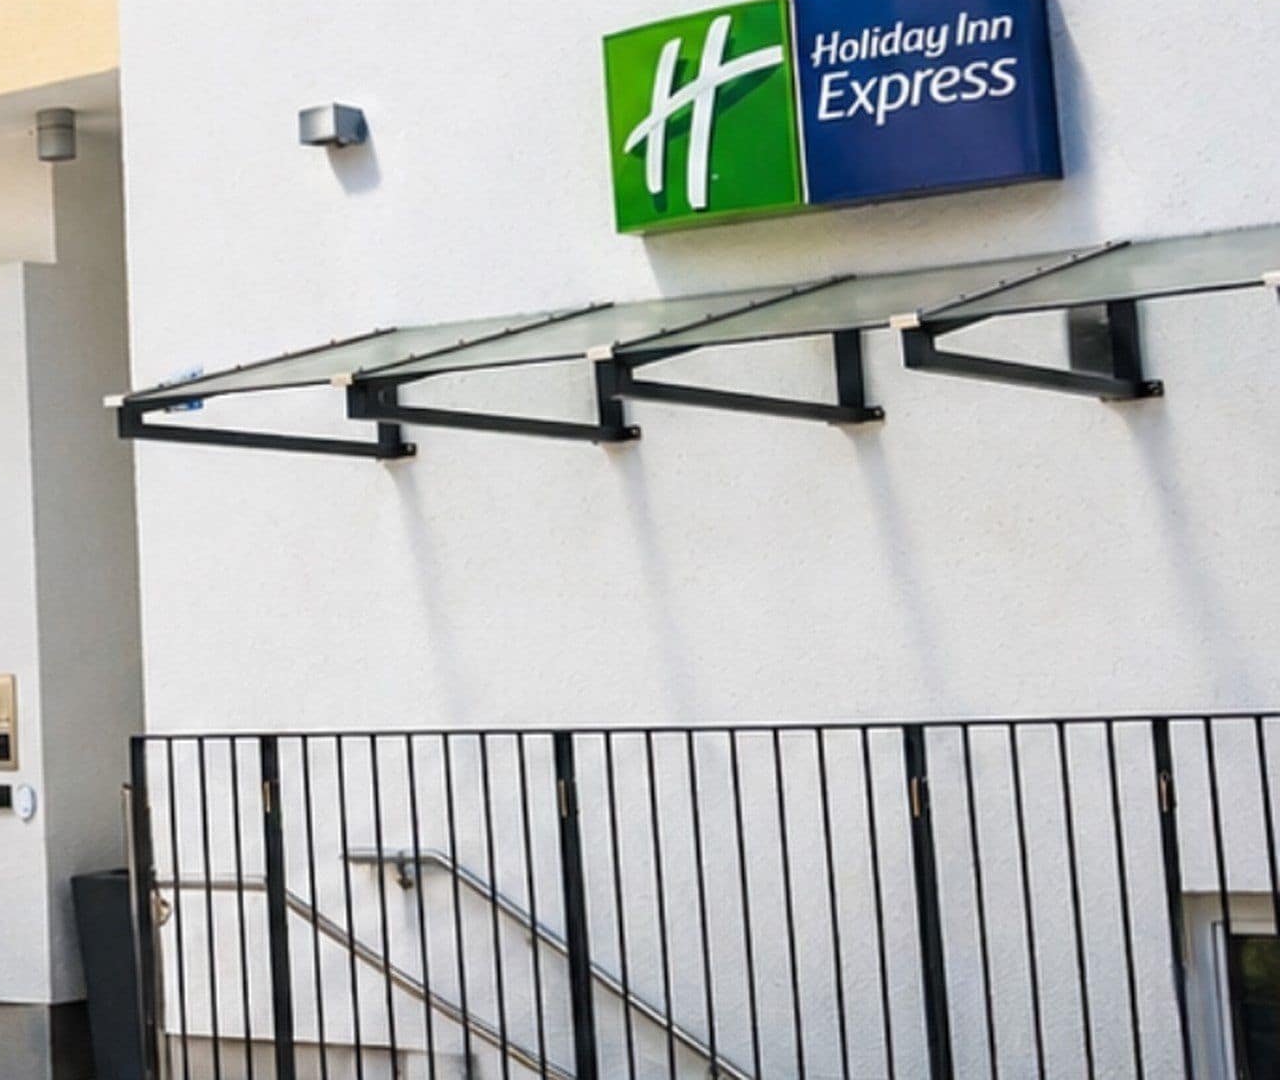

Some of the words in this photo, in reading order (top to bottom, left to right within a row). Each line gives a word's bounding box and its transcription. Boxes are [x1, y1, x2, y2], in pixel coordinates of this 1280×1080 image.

[811, 21, 949, 68] Holiday
[956, 12, 1013, 46] Inn
[818, 57, 1018, 126] Express
